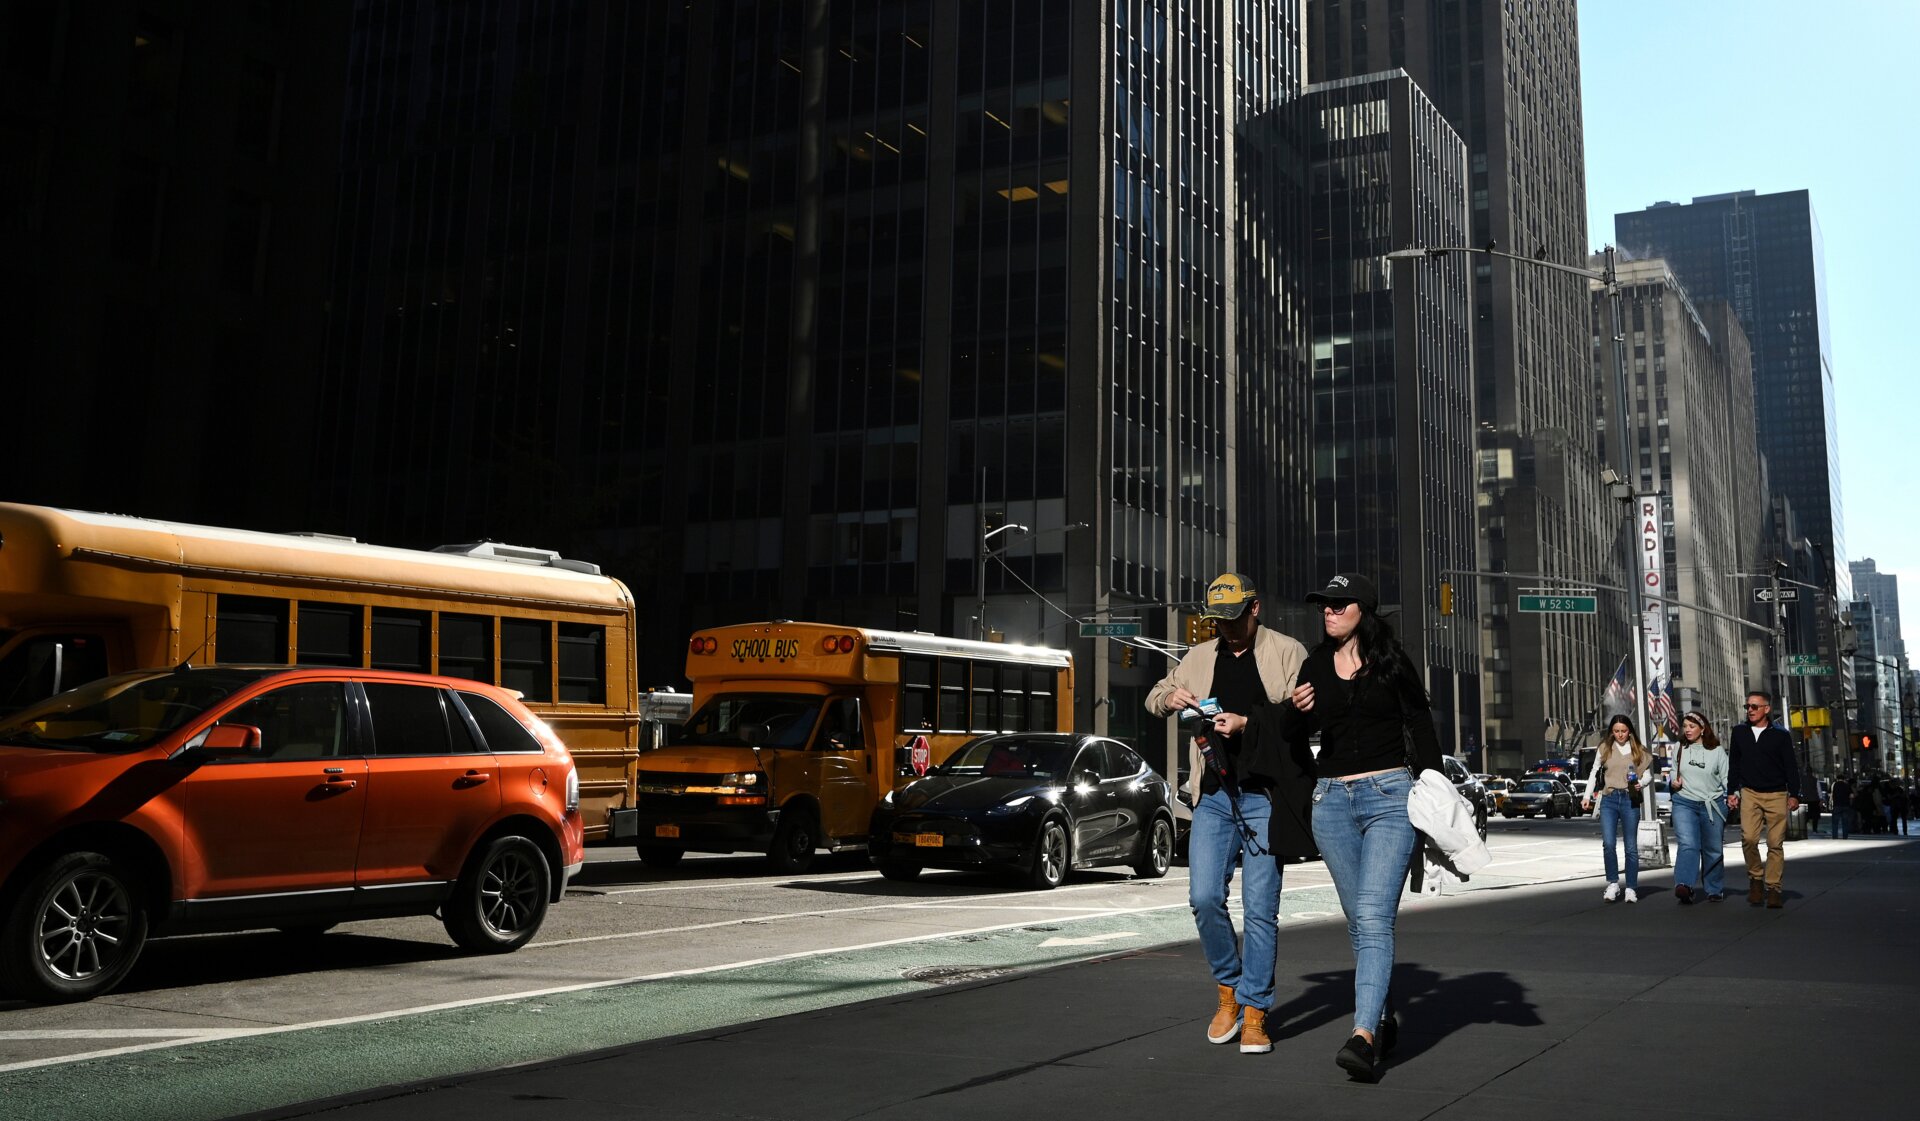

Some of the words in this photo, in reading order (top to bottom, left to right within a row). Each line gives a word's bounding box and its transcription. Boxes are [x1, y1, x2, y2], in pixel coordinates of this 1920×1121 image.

[1643, 503, 1659, 587] RADIO
[1540, 599, 1547, 609] W
[1550, 599, 1561, 609] 52
[1565, 599, 1575, 610] St
[1096, 626, 1102, 635] W
[1104, 625, 1114, 635] 52
[1116, 625, 1124, 635] St
[1647, 602, 1663, 670] CTY
[731, 639, 772, 658] SCHOOL
[774, 639, 799, 658] BUS
[1789, 655, 1796, 664] W
[1799, 655, 1809, 664] 52
[914, 749, 927, 764] STOP
